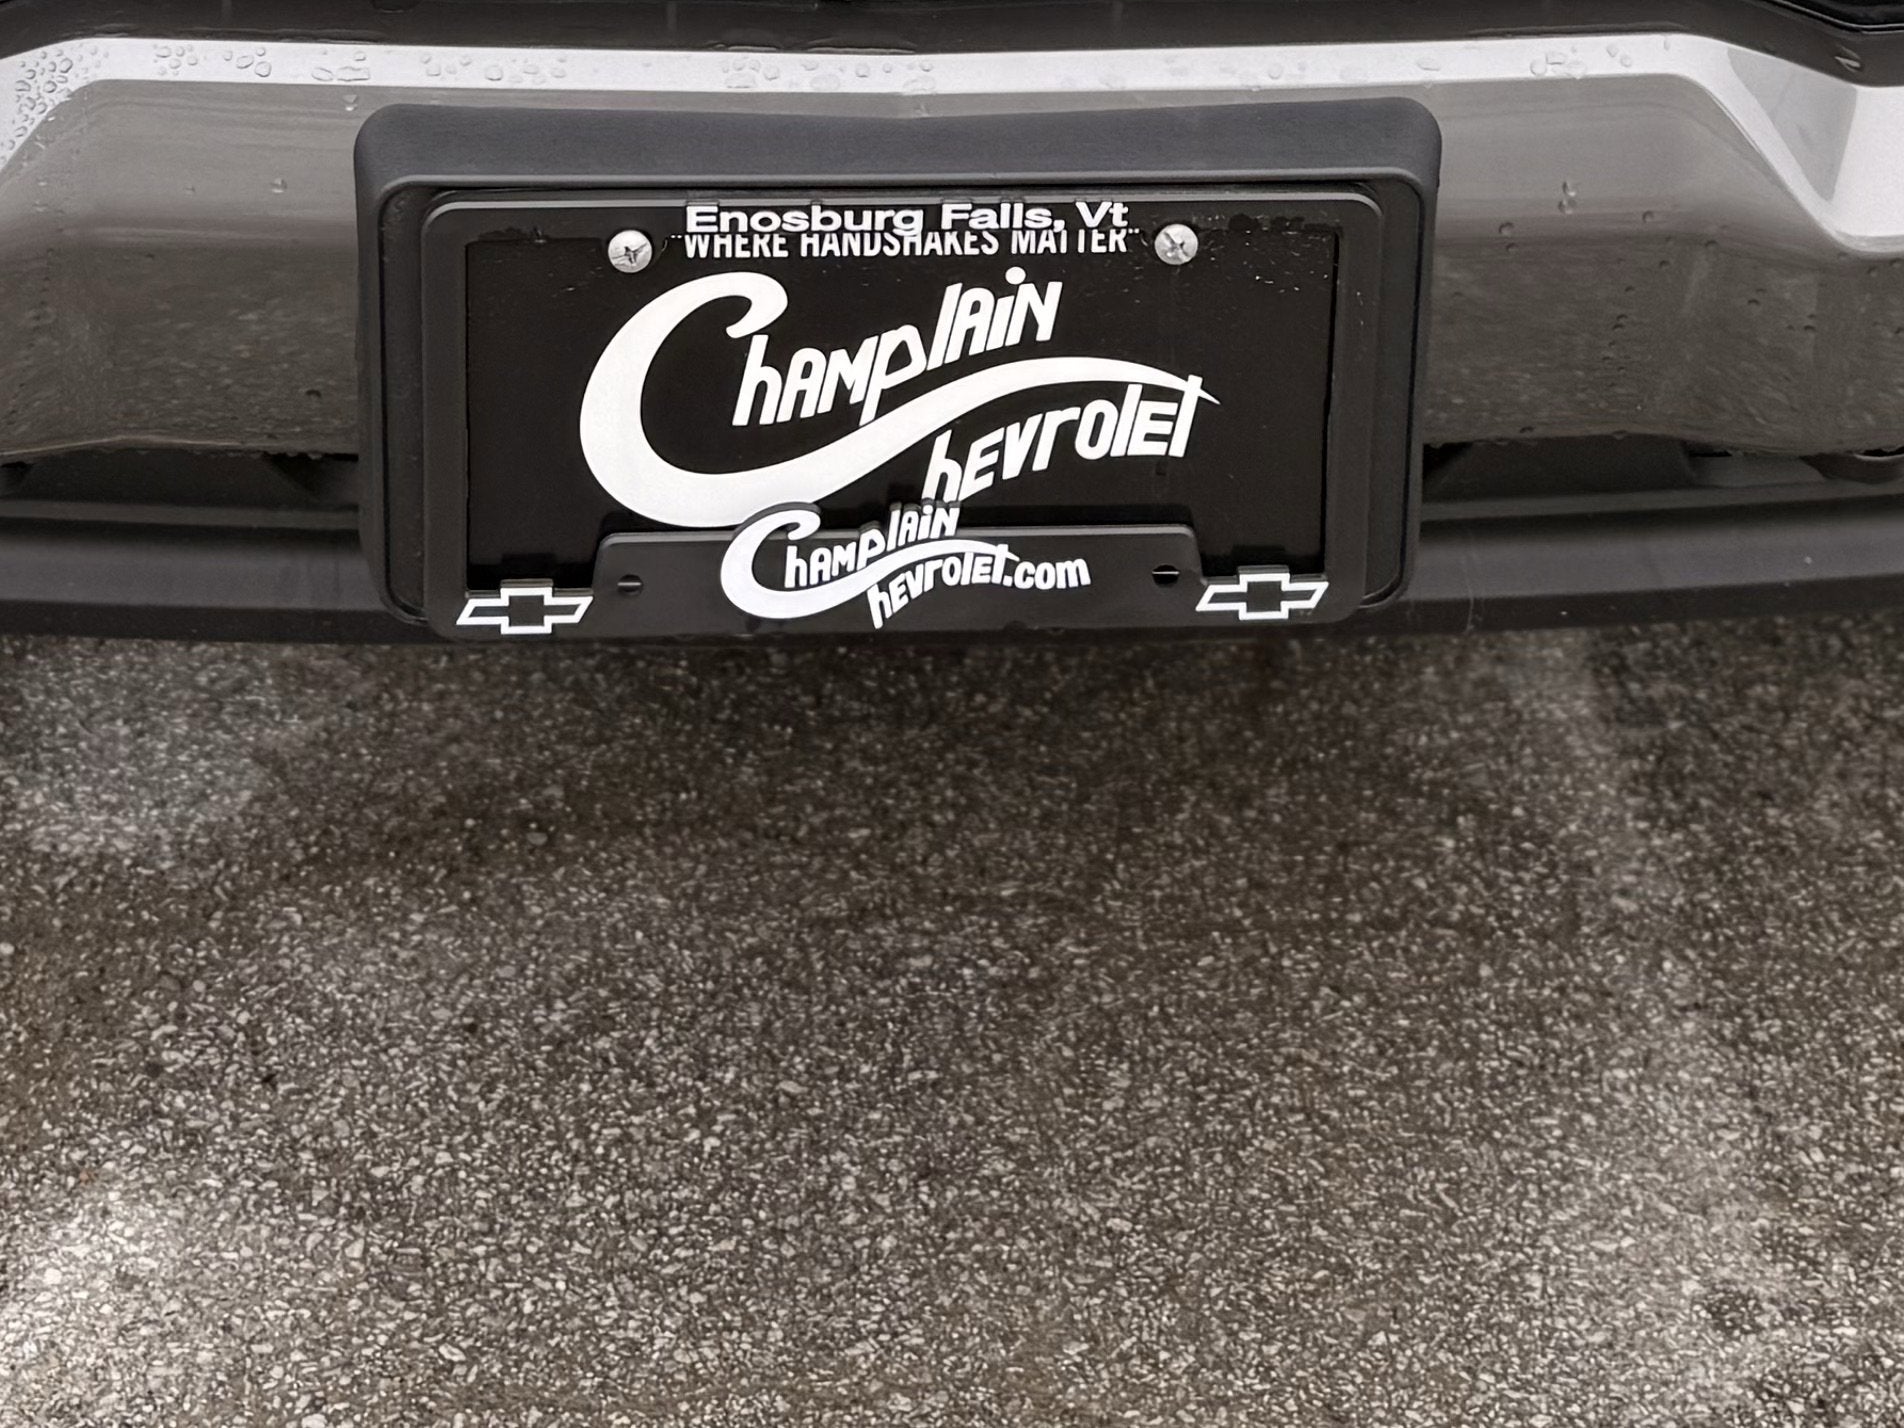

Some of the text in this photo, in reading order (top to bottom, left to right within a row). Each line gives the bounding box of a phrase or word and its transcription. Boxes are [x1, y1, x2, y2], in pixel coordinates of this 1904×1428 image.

[686, 200, 1129, 237] Enosburg Falls, Vt
[800, 229, 999, 257] HANDSHAKES
